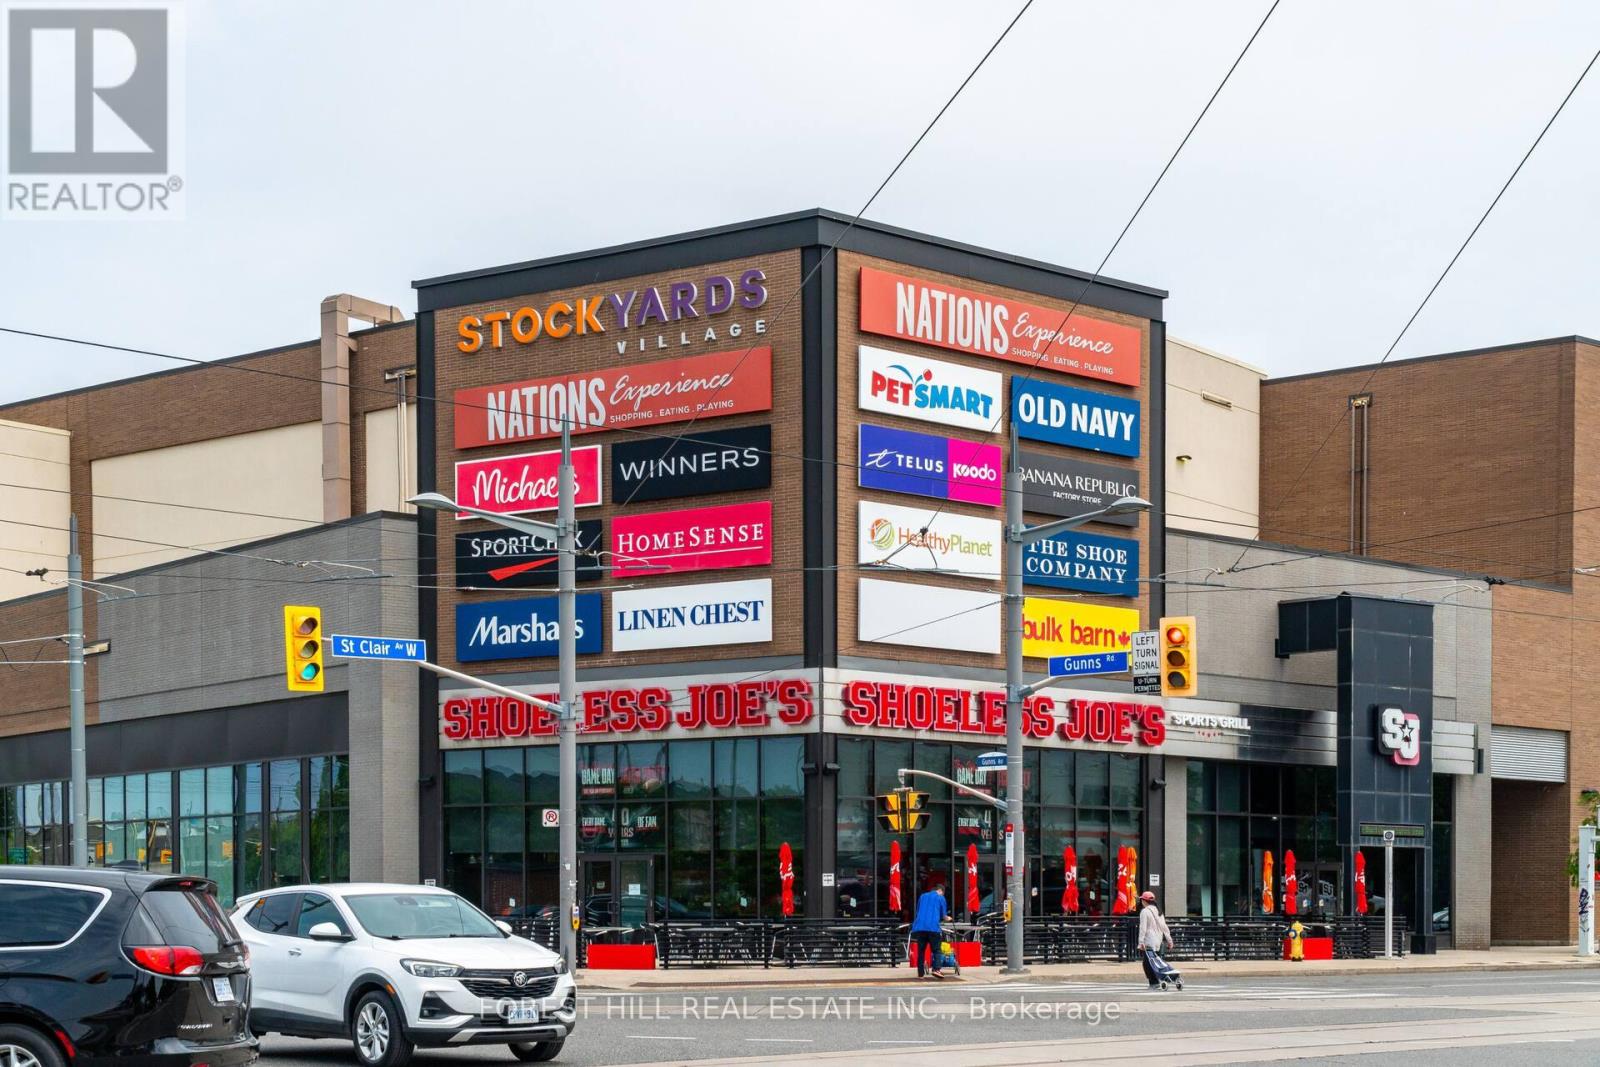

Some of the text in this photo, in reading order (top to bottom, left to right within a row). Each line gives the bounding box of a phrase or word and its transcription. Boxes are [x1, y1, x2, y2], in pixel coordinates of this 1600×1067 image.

[457, 269, 767, 353] STOCKYARDS
[896, 281, 1114, 355] NATIONS Experience
[617, 319, 766, 354] VILLAGE
[1012, 347, 1114, 375] SHOPPING EATING PLAYING
[487, 372, 734, 441] NATIONS Experience
[610, 399, 734, 423] SHOPPING EATING PLAYING
[1018, 393, 1135, 441] OLD NAVY
[619, 447, 761, 482] WINNERS
[895, 454, 944, 473] TELUS
[472, 465, 581, 506] Michaes
[1019, 466, 1137, 499] BANANA REPUBLIC
[1053, 490, 1102, 504] FACTORY STORE
[471, 529, 583, 557] SPORTCHK
[1028, 539, 1127, 565] THE SHOE
[1026, 557, 1127, 583] COMPANY
[469, 613, 584, 647] Marshas
[618, 600, 765, 632] LINEN CHEST
[1022, 614, 1116, 648] bulk barn
[1136, 636, 1155, 646] LEFT
[341, 639, 417, 657] St Clair Av W
[1136, 648, 1157, 658] TURN
[1064, 658, 1102, 671] Gunns
[1134, 661, 1159, 670] SIGNAL
[1137, 677, 1158, 685] U-TURN
[443, 679, 814, 741] SHOEESS JOE'S
[1061, 698, 1166, 747] JOE'S
[1171, 713, 1251, 731] SPORTS GRILL
[982, 758, 996, 766] Gunns
